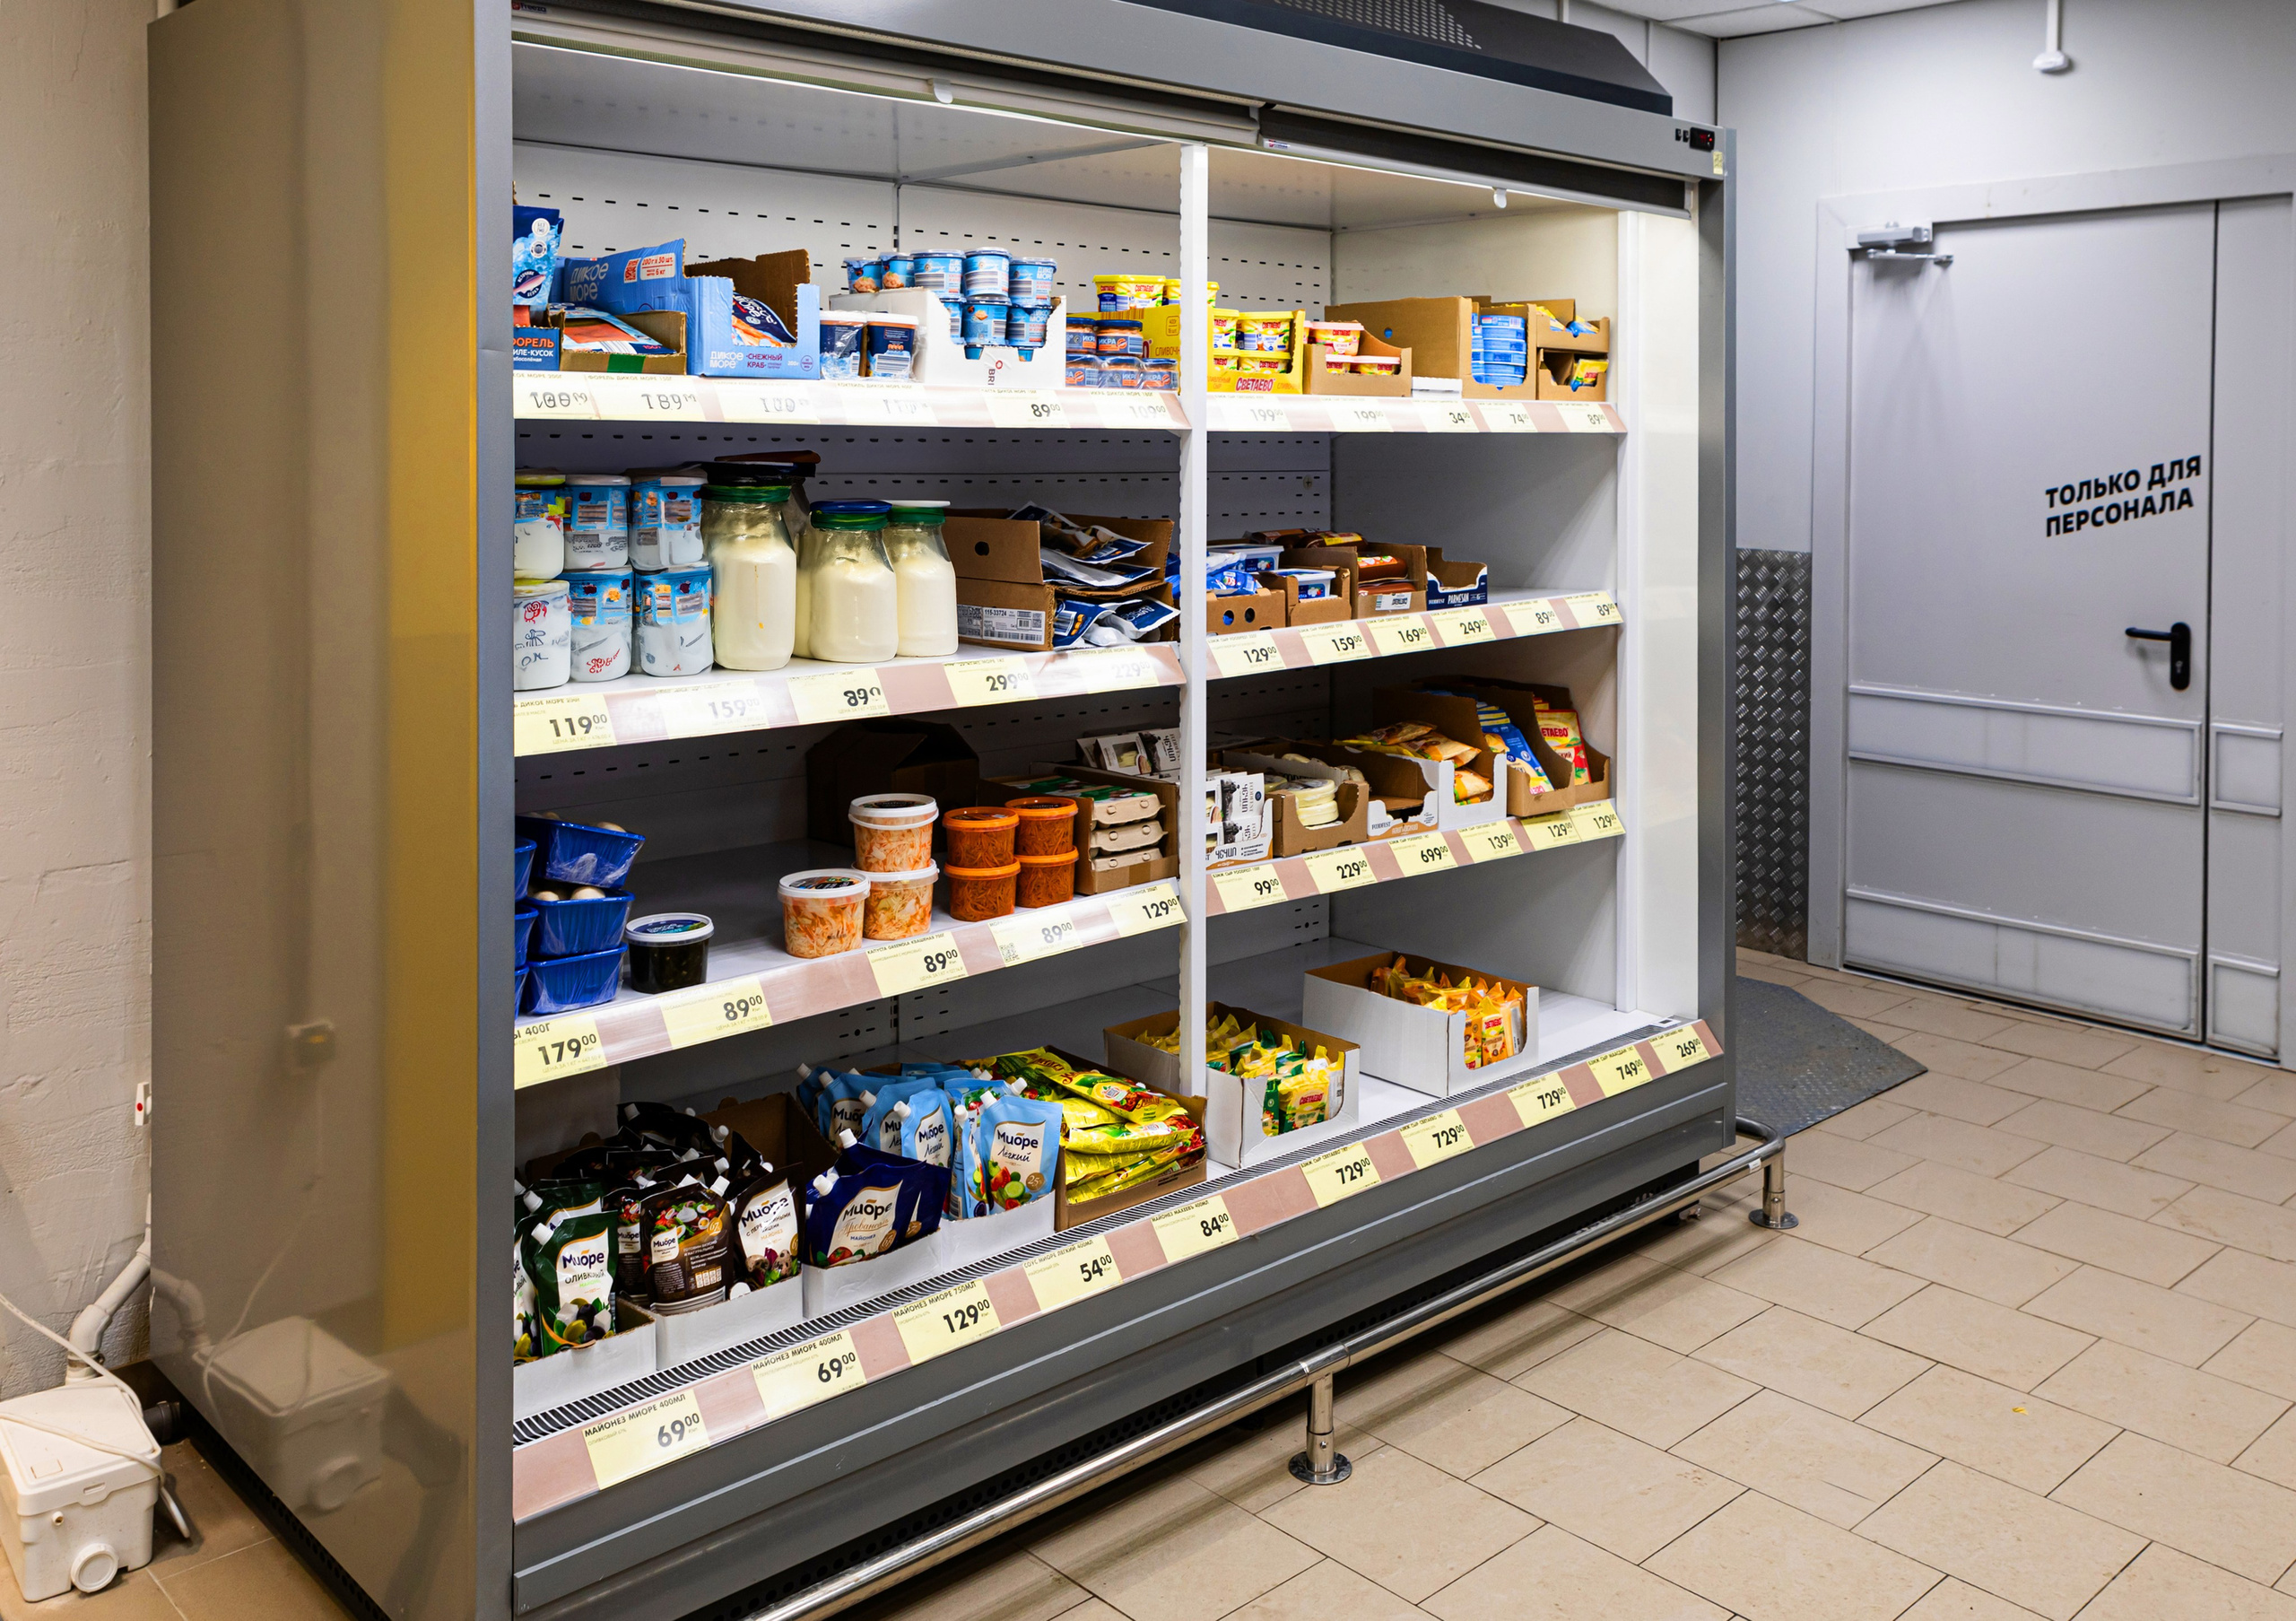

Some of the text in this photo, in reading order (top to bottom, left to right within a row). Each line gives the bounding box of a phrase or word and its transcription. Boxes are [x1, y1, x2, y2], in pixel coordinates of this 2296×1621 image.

[1213, 318, 1227, 327] ТАЕВО
[513, 349, 553, 357] ИЛЕ-КУСОК
[1213, 358, 1227, 366] ТАЕВО
[1235, 377, 1275, 392] СВЕТАЕВО
[2045, 455, 2202, 509] ТОЛЬКО ДЛЯ
[2046, 487, 2195, 538] ПЕРСОНАЛА
[520, 699, 544, 708] ДИКОЕ
[545, 697, 565, 705] МОРЕ
[526, 1023, 551, 1036] 400Г
[543, 1065, 559, 1073] ЦЕНА
[997, 1129, 1039, 1150] Миоре
[997, 1146, 1031, 1163] Лёгкий
[842, 1202, 893, 1221] Миоре
[653, 1236, 676, 1248] Миоре
[562, 1252, 604, 1269] Миоре
[1039, 1253, 1057, 1263] МИОРЕ
[1057, 1245, 1076, 1256] ЛЕГКИЙ
[893, 1281, 977, 1318] МАЙОНЕЗ МИОРЕ 750МЛ
[752, 1334, 843, 1371] МАЙОНЕЗ МИОРЕ 400МЛ
[585, 1393, 686, 1437] МАЙОНЕЗ МИОРЕ 400МЛ
[587, 1431, 617, 1446] ОЛИВКОВЫЙ
